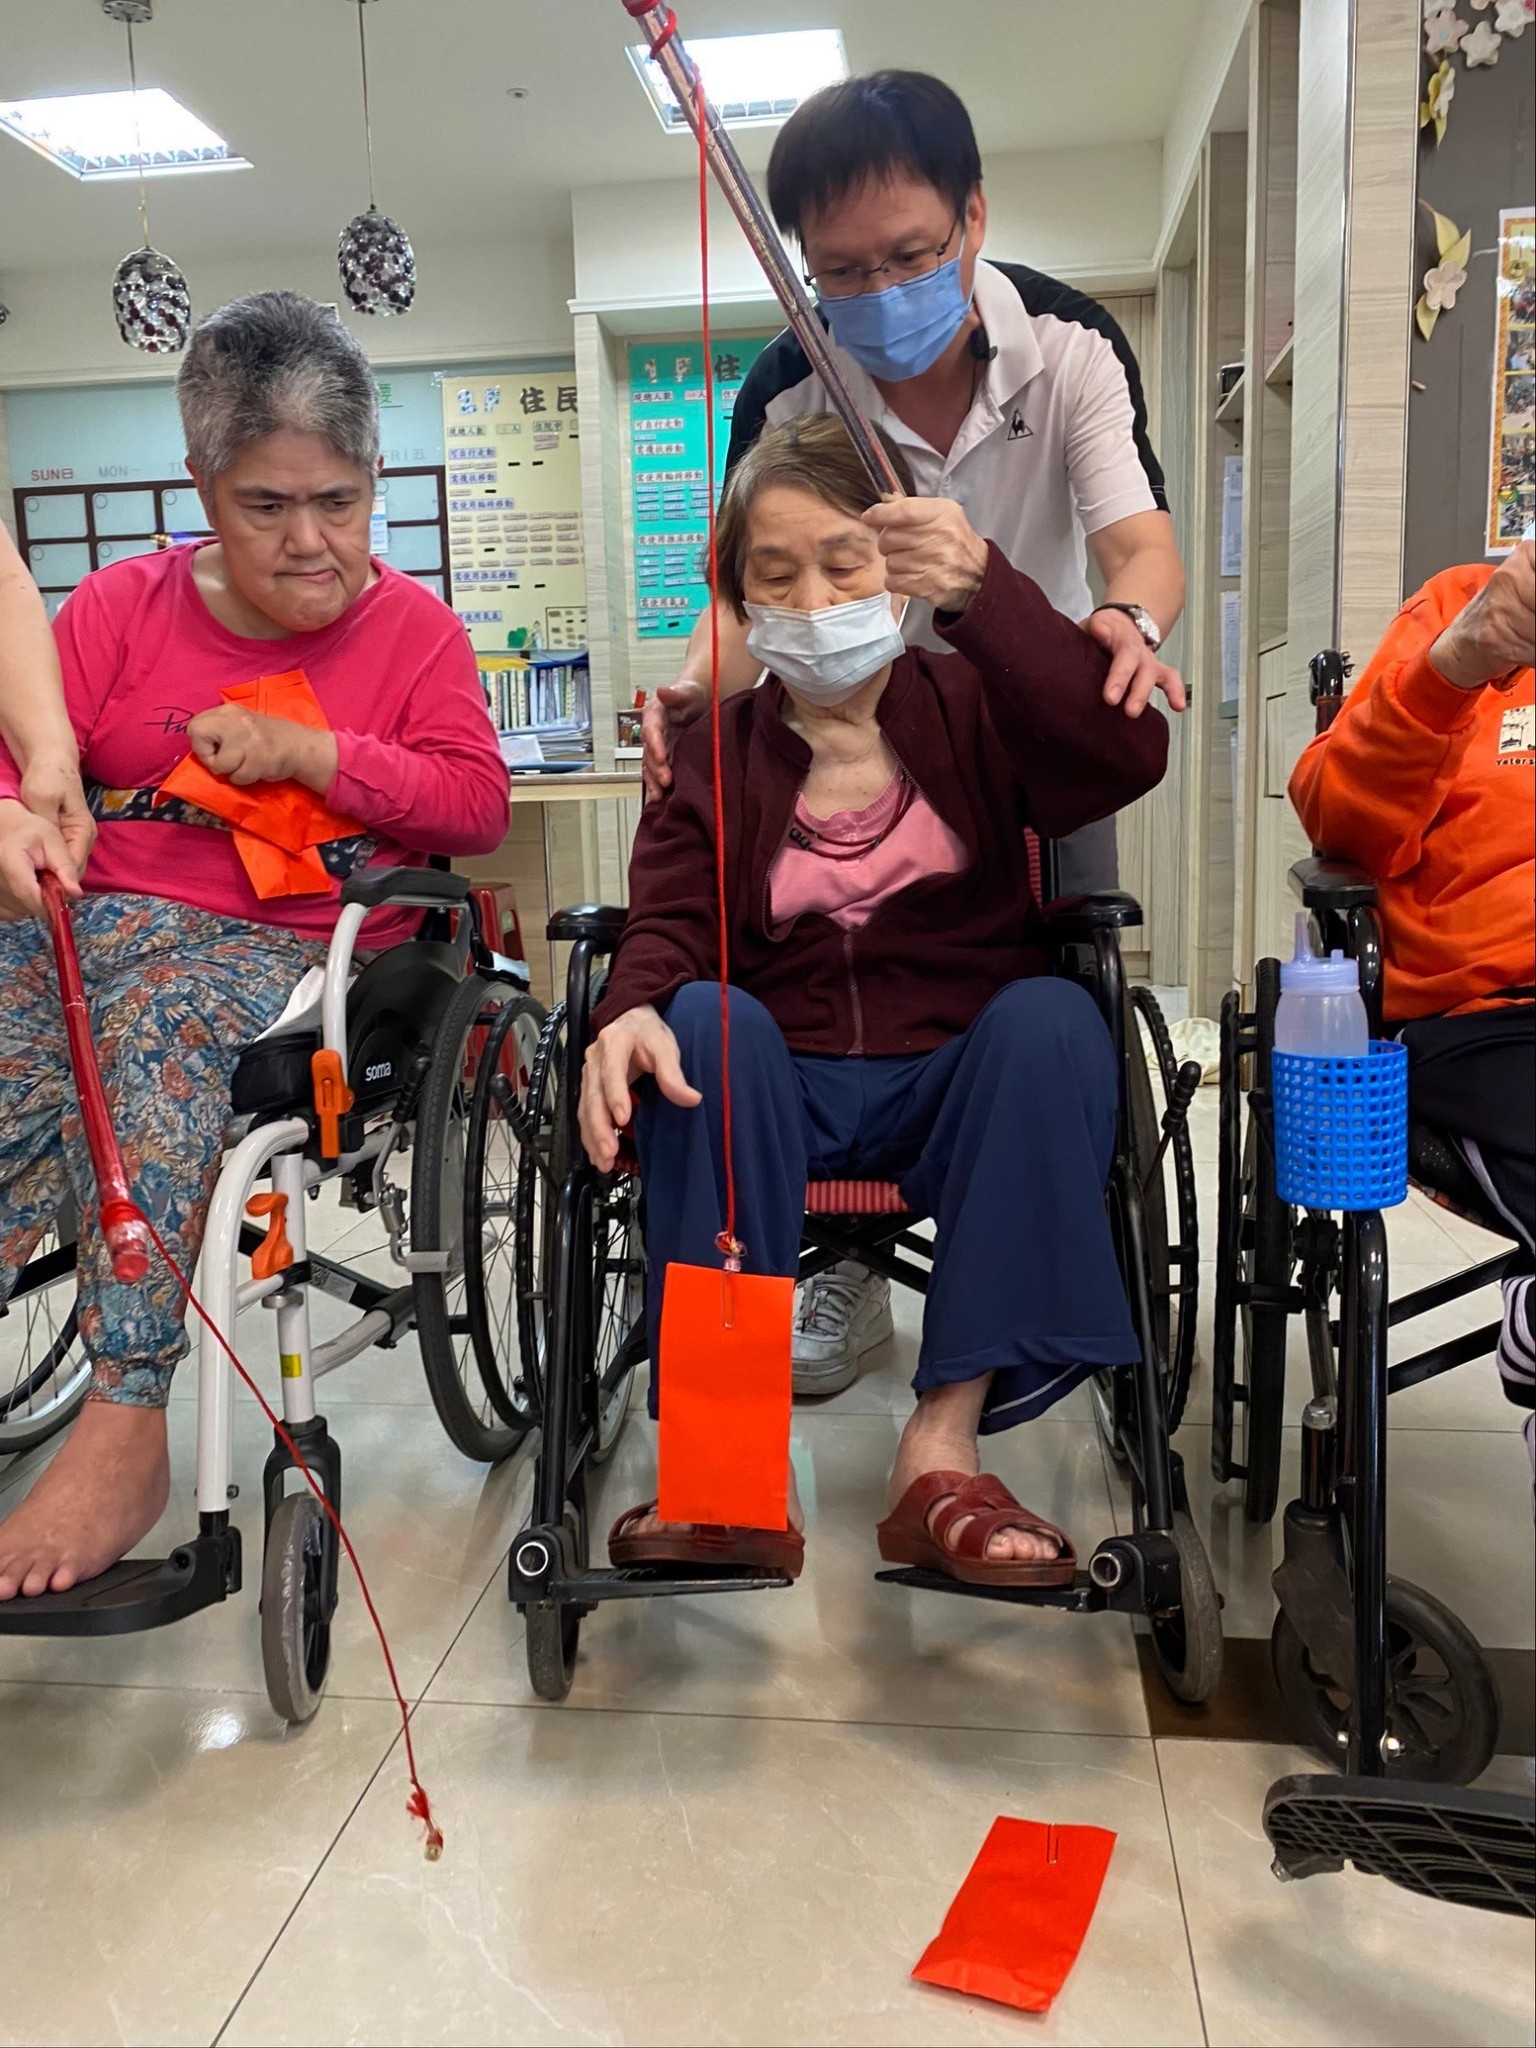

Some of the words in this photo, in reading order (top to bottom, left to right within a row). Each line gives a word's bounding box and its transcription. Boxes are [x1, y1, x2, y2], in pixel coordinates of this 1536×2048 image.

[644, 357, 692, 384] 1F
[714, 354, 743, 383] 住
[520, 387, 577, 415] 住民
[365, 1061, 391, 1082] soma
